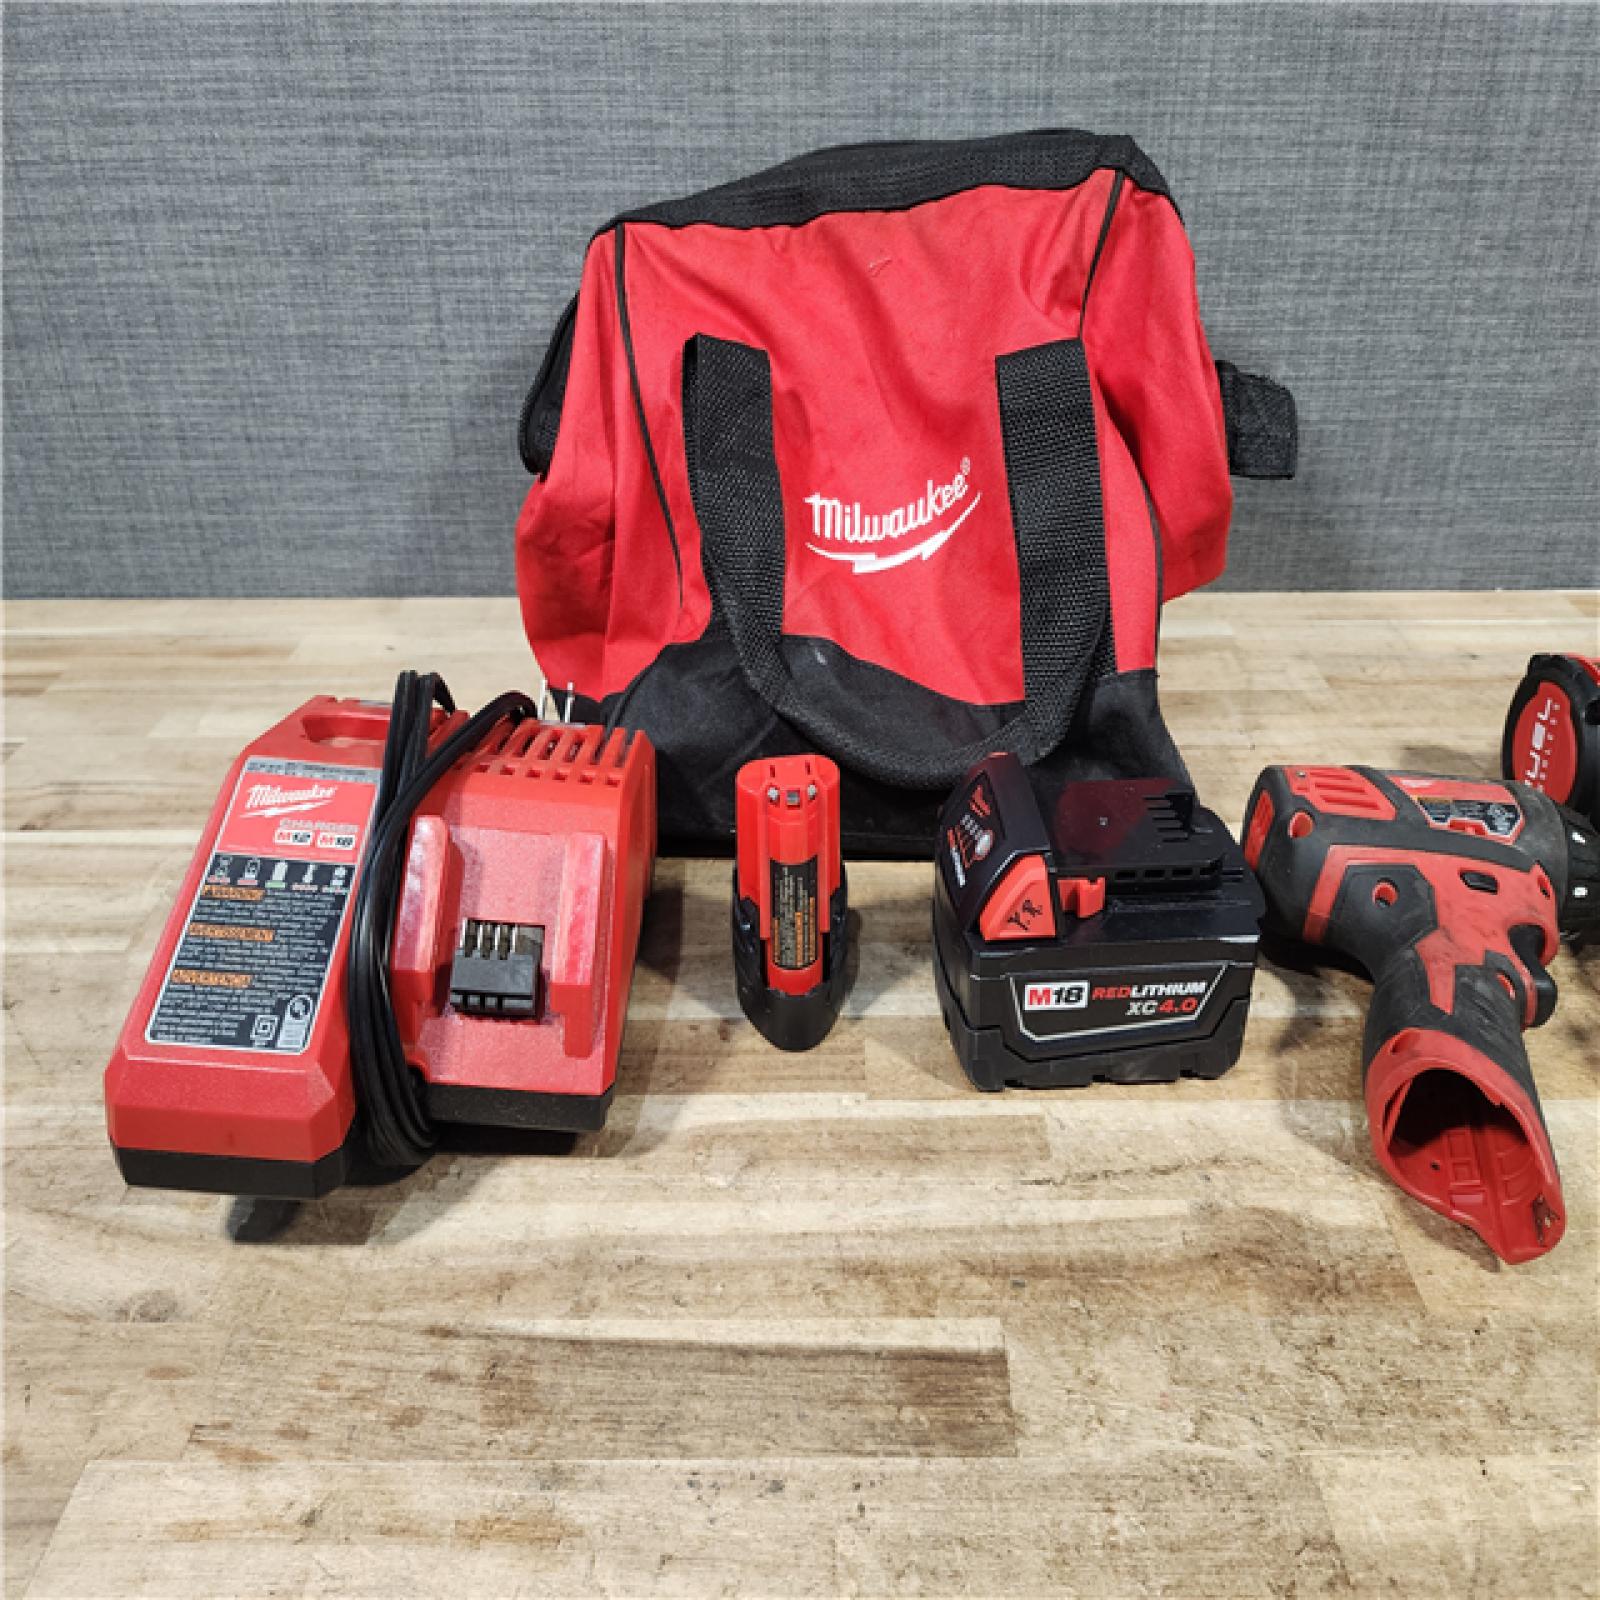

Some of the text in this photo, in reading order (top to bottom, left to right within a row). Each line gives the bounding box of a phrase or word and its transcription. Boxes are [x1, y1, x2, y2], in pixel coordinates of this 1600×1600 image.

[803, 473, 968, 543] Milwaukee
[1028, 981, 1207, 1007] M18 REDLITHIUM
